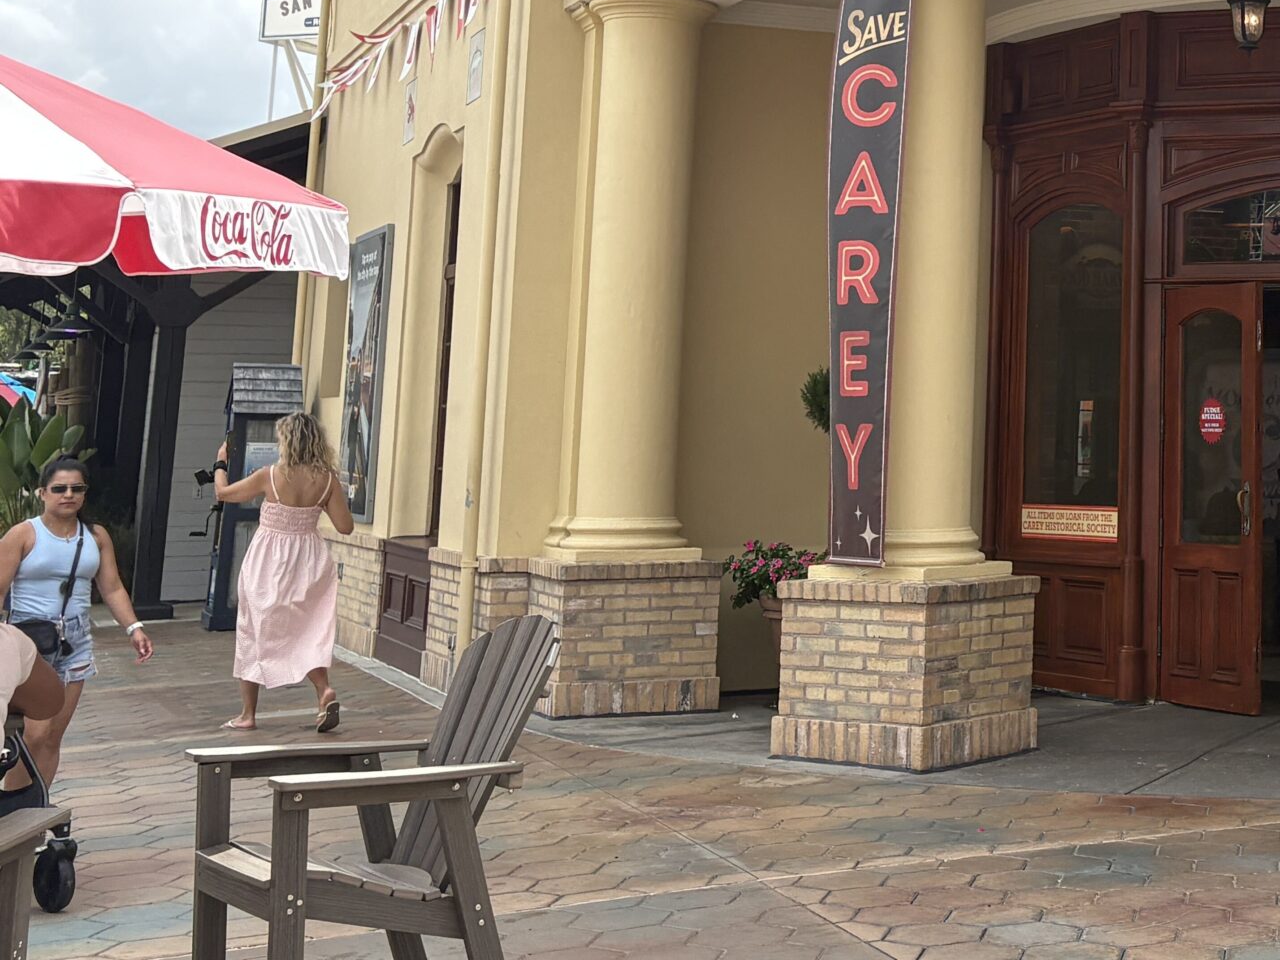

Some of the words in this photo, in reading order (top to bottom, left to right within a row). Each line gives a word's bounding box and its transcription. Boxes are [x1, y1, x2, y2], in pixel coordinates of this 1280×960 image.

[843, 9, 907, 55] SAVE
[834, 63, 898, 490] CAREY
[1022, 520, 1044, 530] CAREY
[1045, 521, 1085, 533] HISTORICAL
[1086, 523, 1117, 535] SOCIETY
[1026, 511, 1037, 520] ALL
[1038, 511, 1055, 520] ITEMS
[1056, 512, 1065, 520] ON
[1065, 512, 1081, 521] LOAN
[1082, 513, 1099, 522] FROM
[1100, 513, 1113, 522] THE
